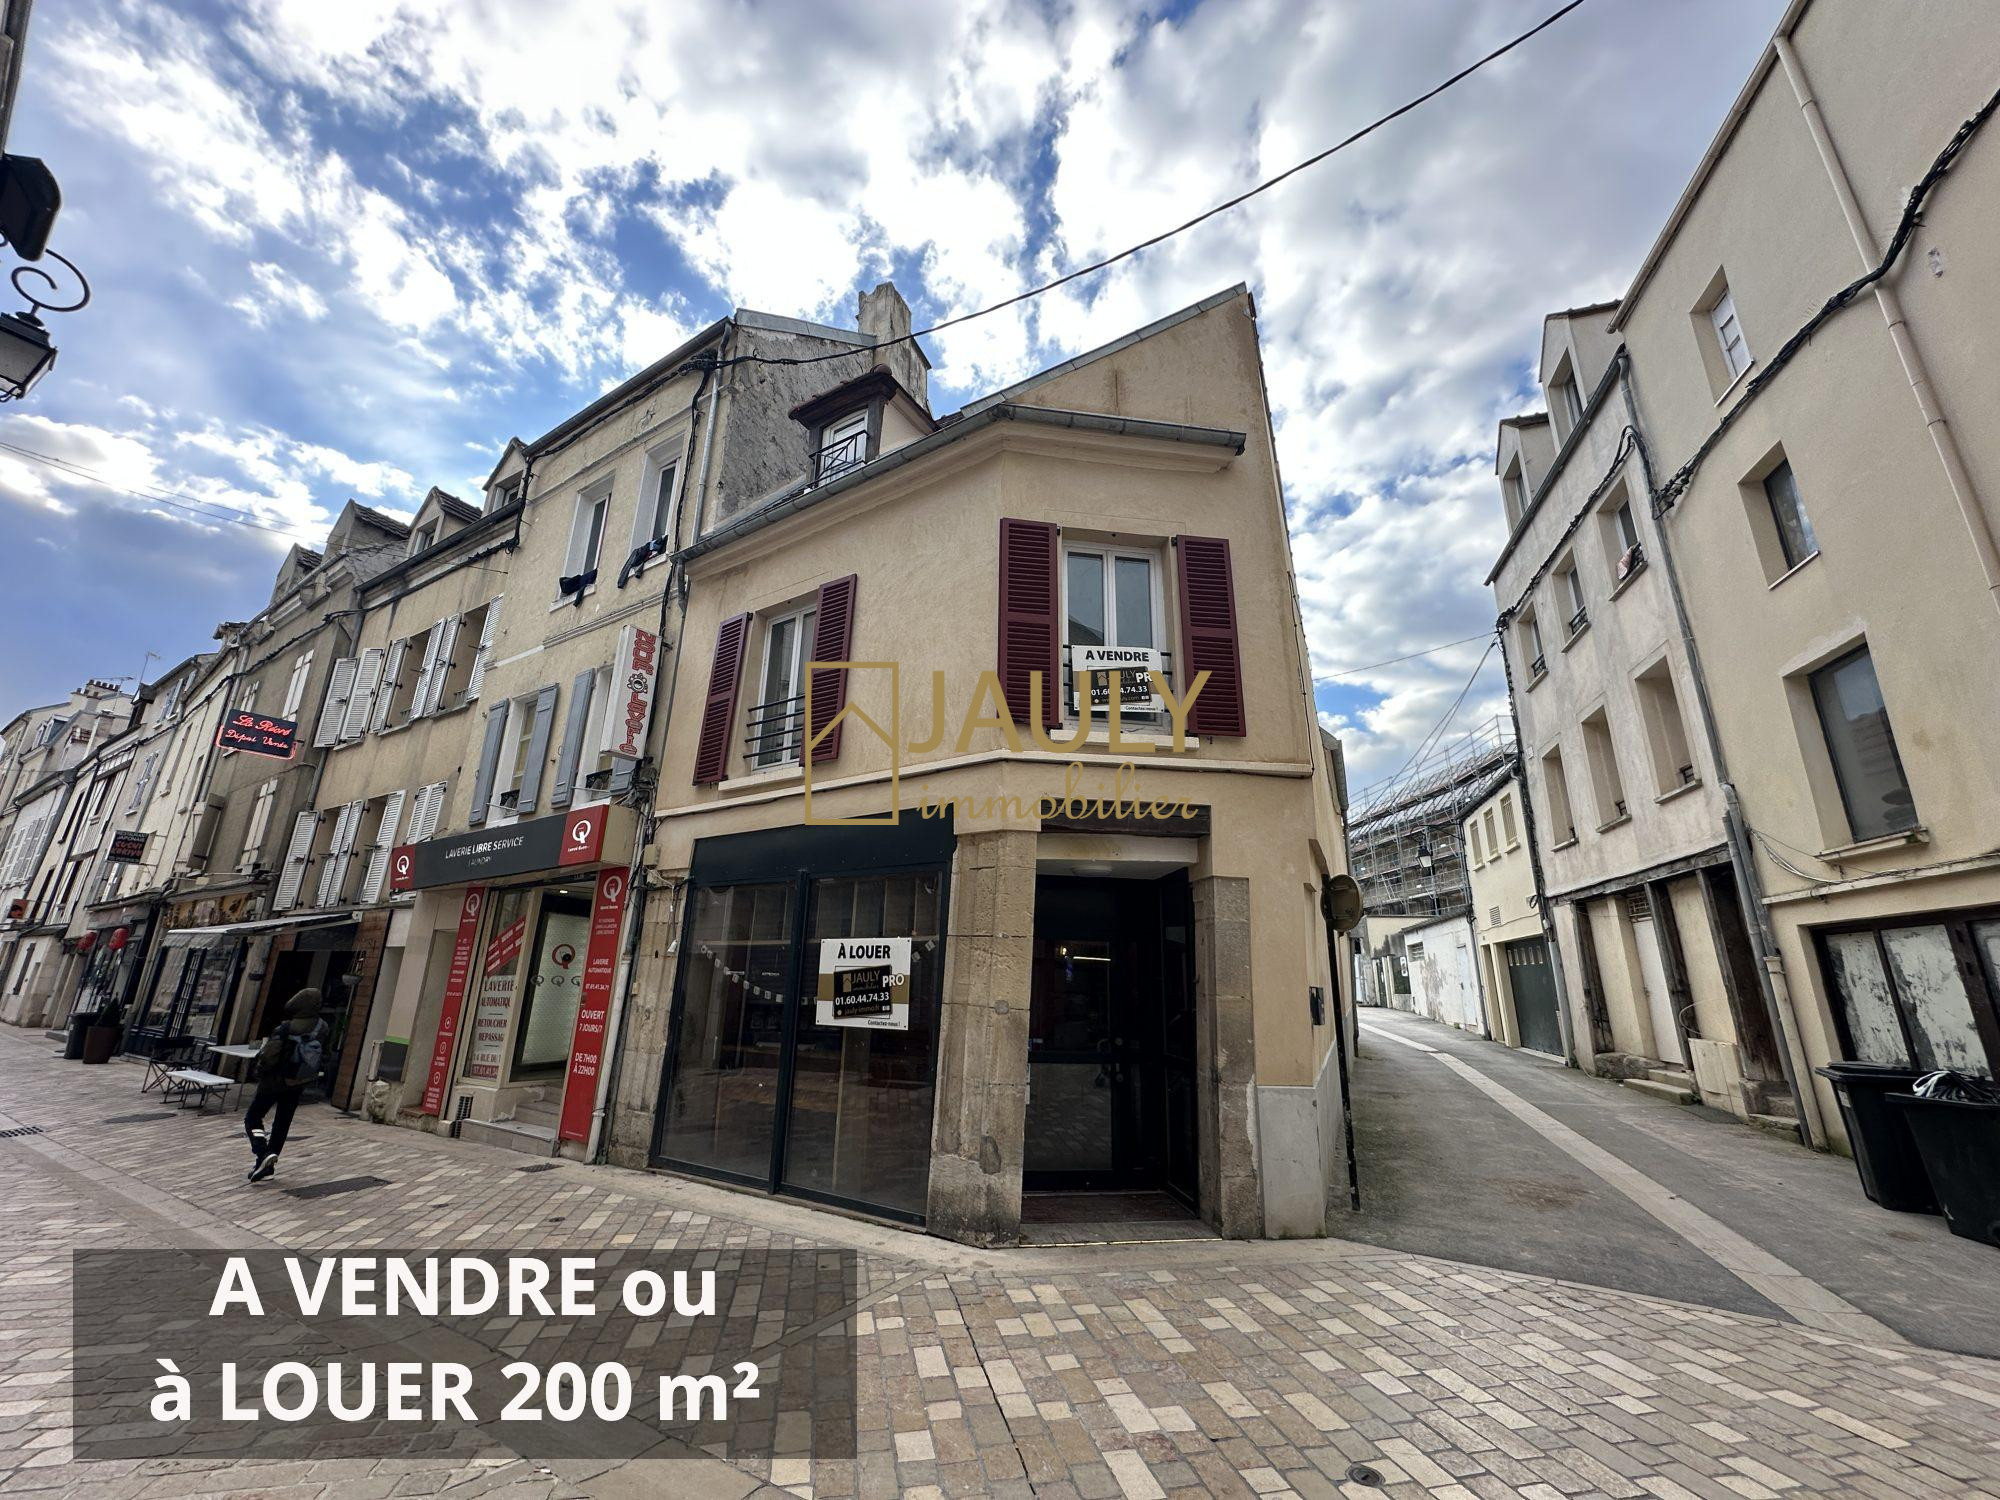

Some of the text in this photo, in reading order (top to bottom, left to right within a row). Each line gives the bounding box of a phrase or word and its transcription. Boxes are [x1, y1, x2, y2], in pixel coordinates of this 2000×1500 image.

[1086, 650, 1149, 662] A VENDRE
[1135, 672, 1153, 683] PR
[445, 836, 524, 859] LAVERIE LIBRE SERVICE
[838, 942, 891, 959] À LOUER
[851, 970, 880, 984] JAULY
[882, 973, 905, 988] PRO
[484, 980, 514, 992] LAVERIE
[835, 991, 890, 1005] 01.60.44.74.33
[581, 1009, 605, 1020] OUVERT
[575, 1052, 597, 1064] DE 7H00
[573, 1062, 595, 1076] À 22H00
